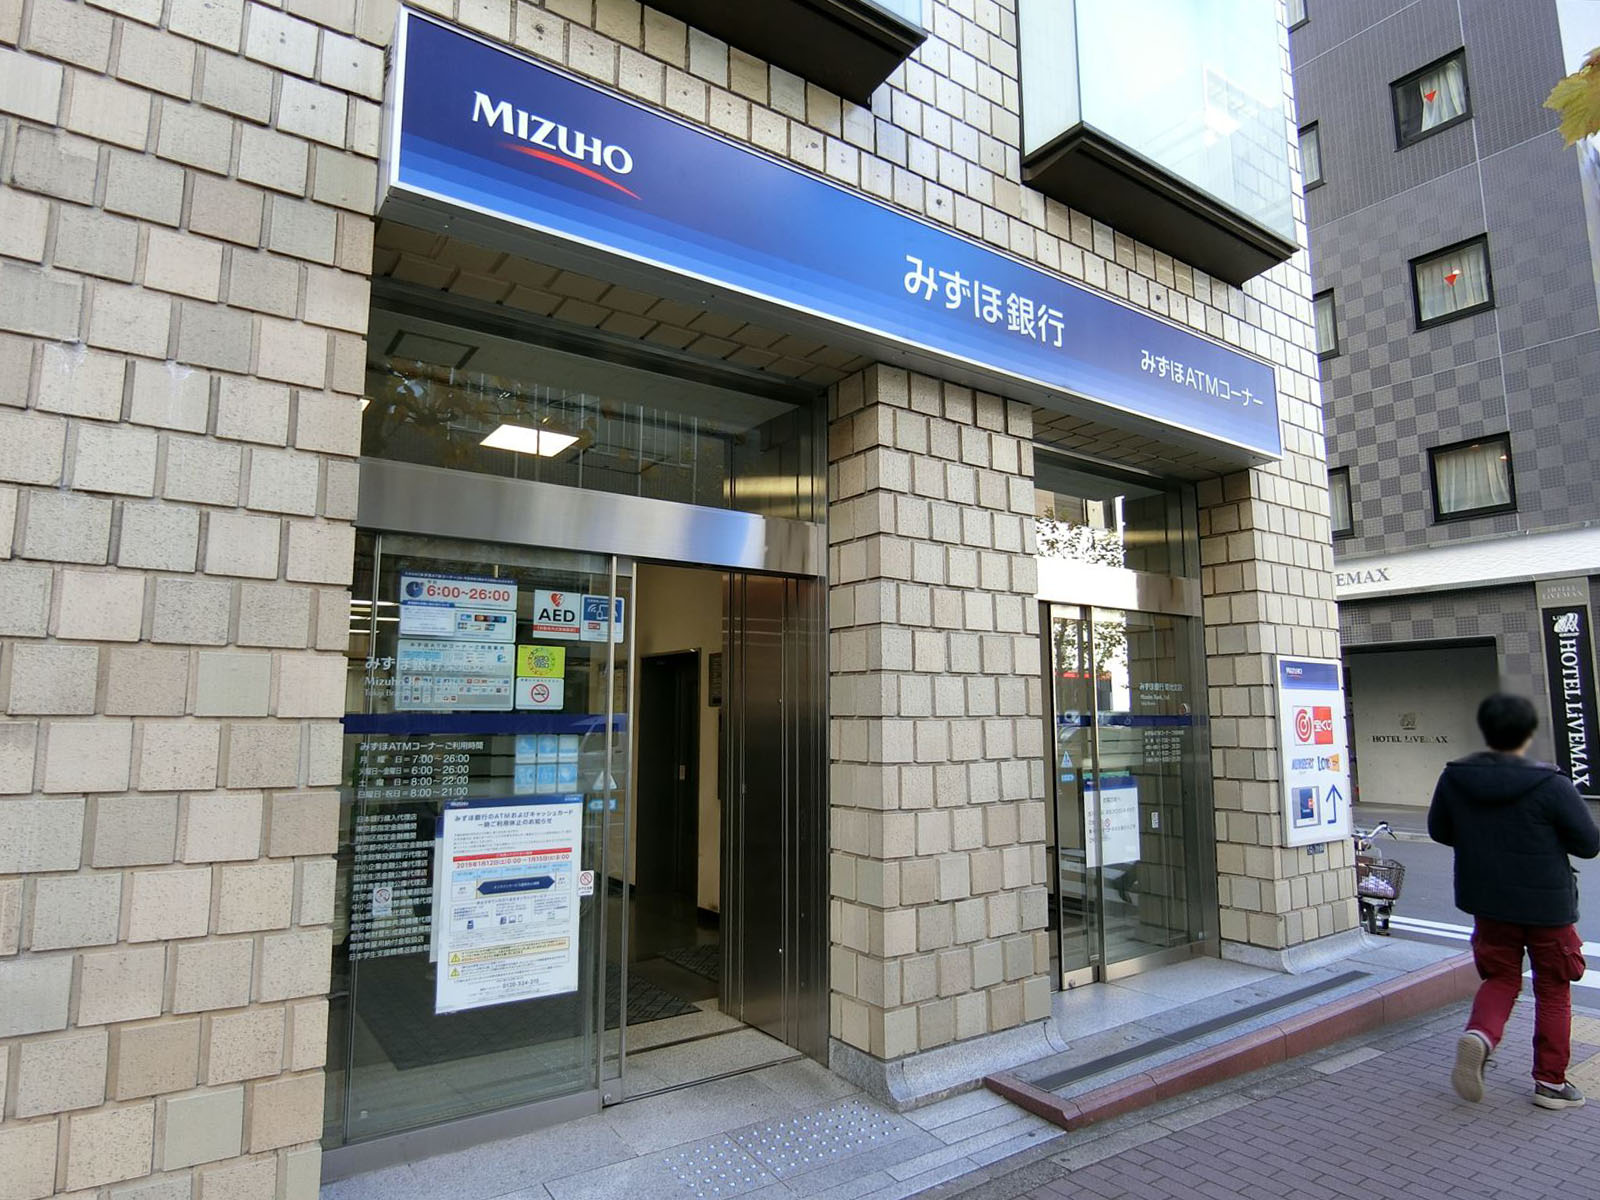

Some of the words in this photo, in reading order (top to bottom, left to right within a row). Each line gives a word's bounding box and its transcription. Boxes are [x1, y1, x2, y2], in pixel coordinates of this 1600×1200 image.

[472, 90, 633, 174] MIZUHO
[904, 255, 1065, 348] みずほ銀行
[1140, 349, 1264, 407] みずほATMコーナー
[538, 608, 576, 622] AED
[1559, 638, 1582, 702] HOTEL
[1372, 735, 1402, 743] HOTEL
